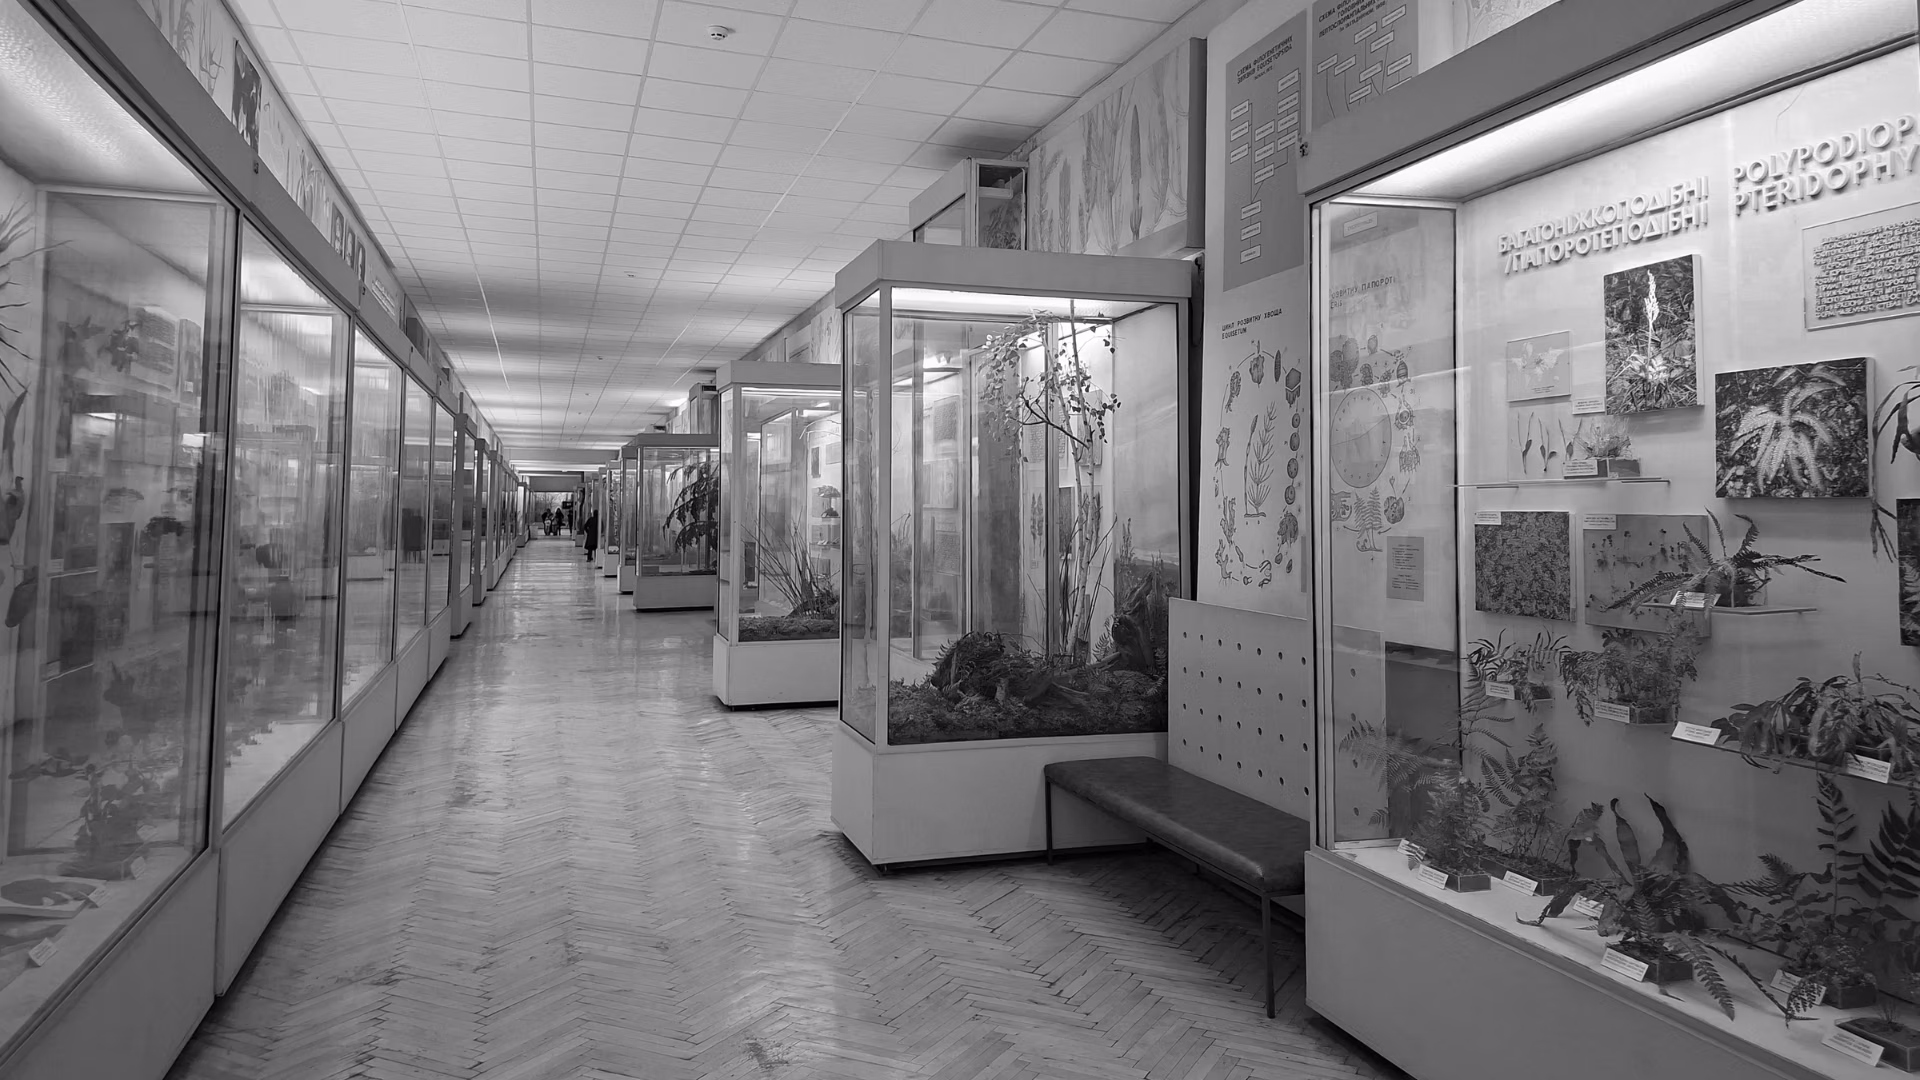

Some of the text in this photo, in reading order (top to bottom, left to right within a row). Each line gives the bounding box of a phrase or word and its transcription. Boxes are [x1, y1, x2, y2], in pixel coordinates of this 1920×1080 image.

[1733, 114, 1920, 190] POLYPODIOP
[1498, 175, 1709, 254] БАГАТОНІЖКОПОДІБНІ
[1331, 285, 1358, 299] ОЗВИТКУ
